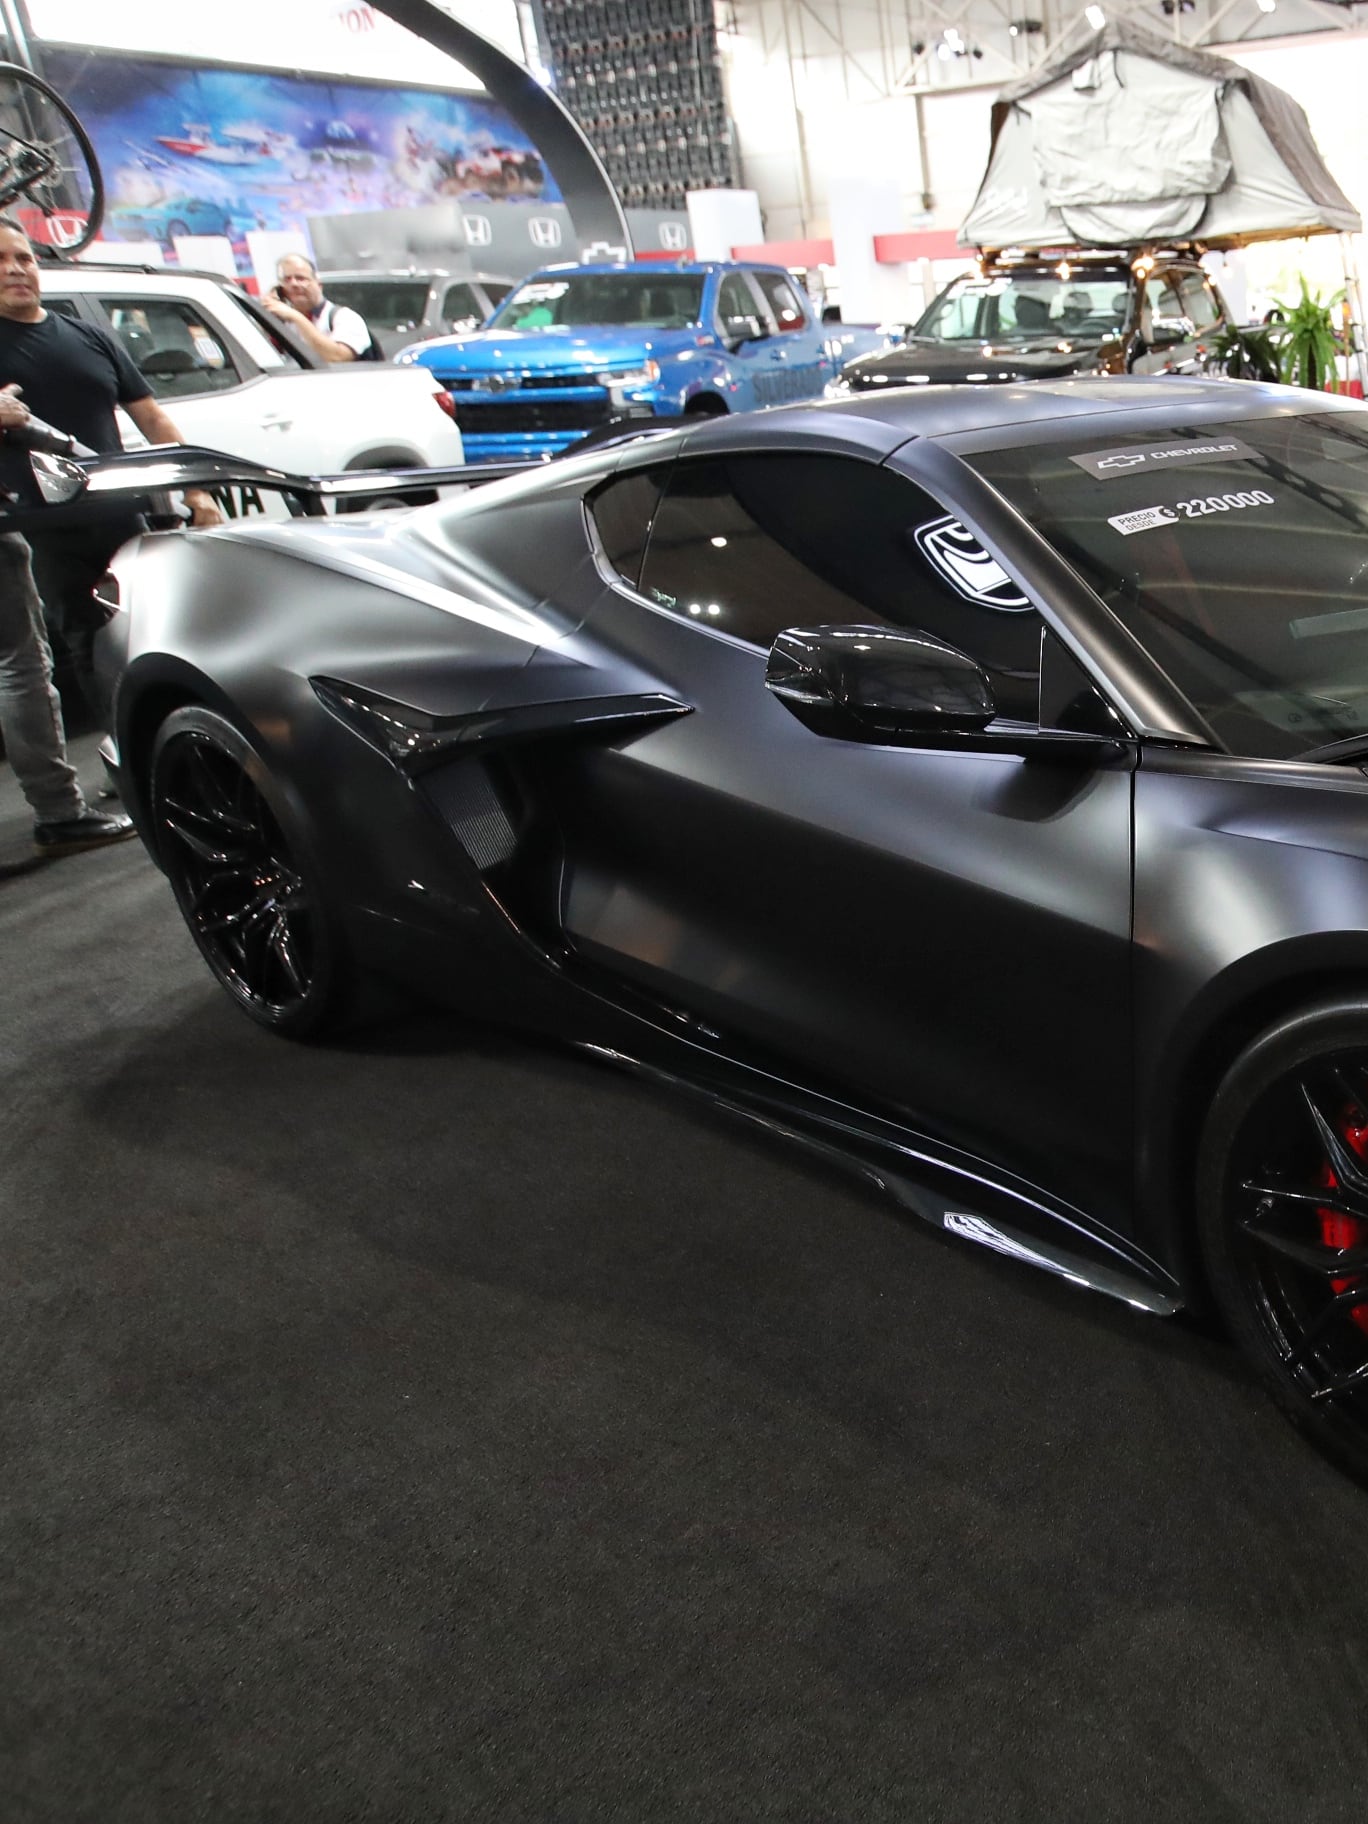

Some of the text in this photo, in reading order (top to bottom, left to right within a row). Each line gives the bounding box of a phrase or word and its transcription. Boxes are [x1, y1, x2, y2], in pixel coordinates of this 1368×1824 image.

[1150, 444, 1239, 459] CHEVROLET
[1176, 490, 1275, 518] 220000
[1117, 511, 1157, 526] PRECIO
[1126, 519, 1155, 531] DESDE
